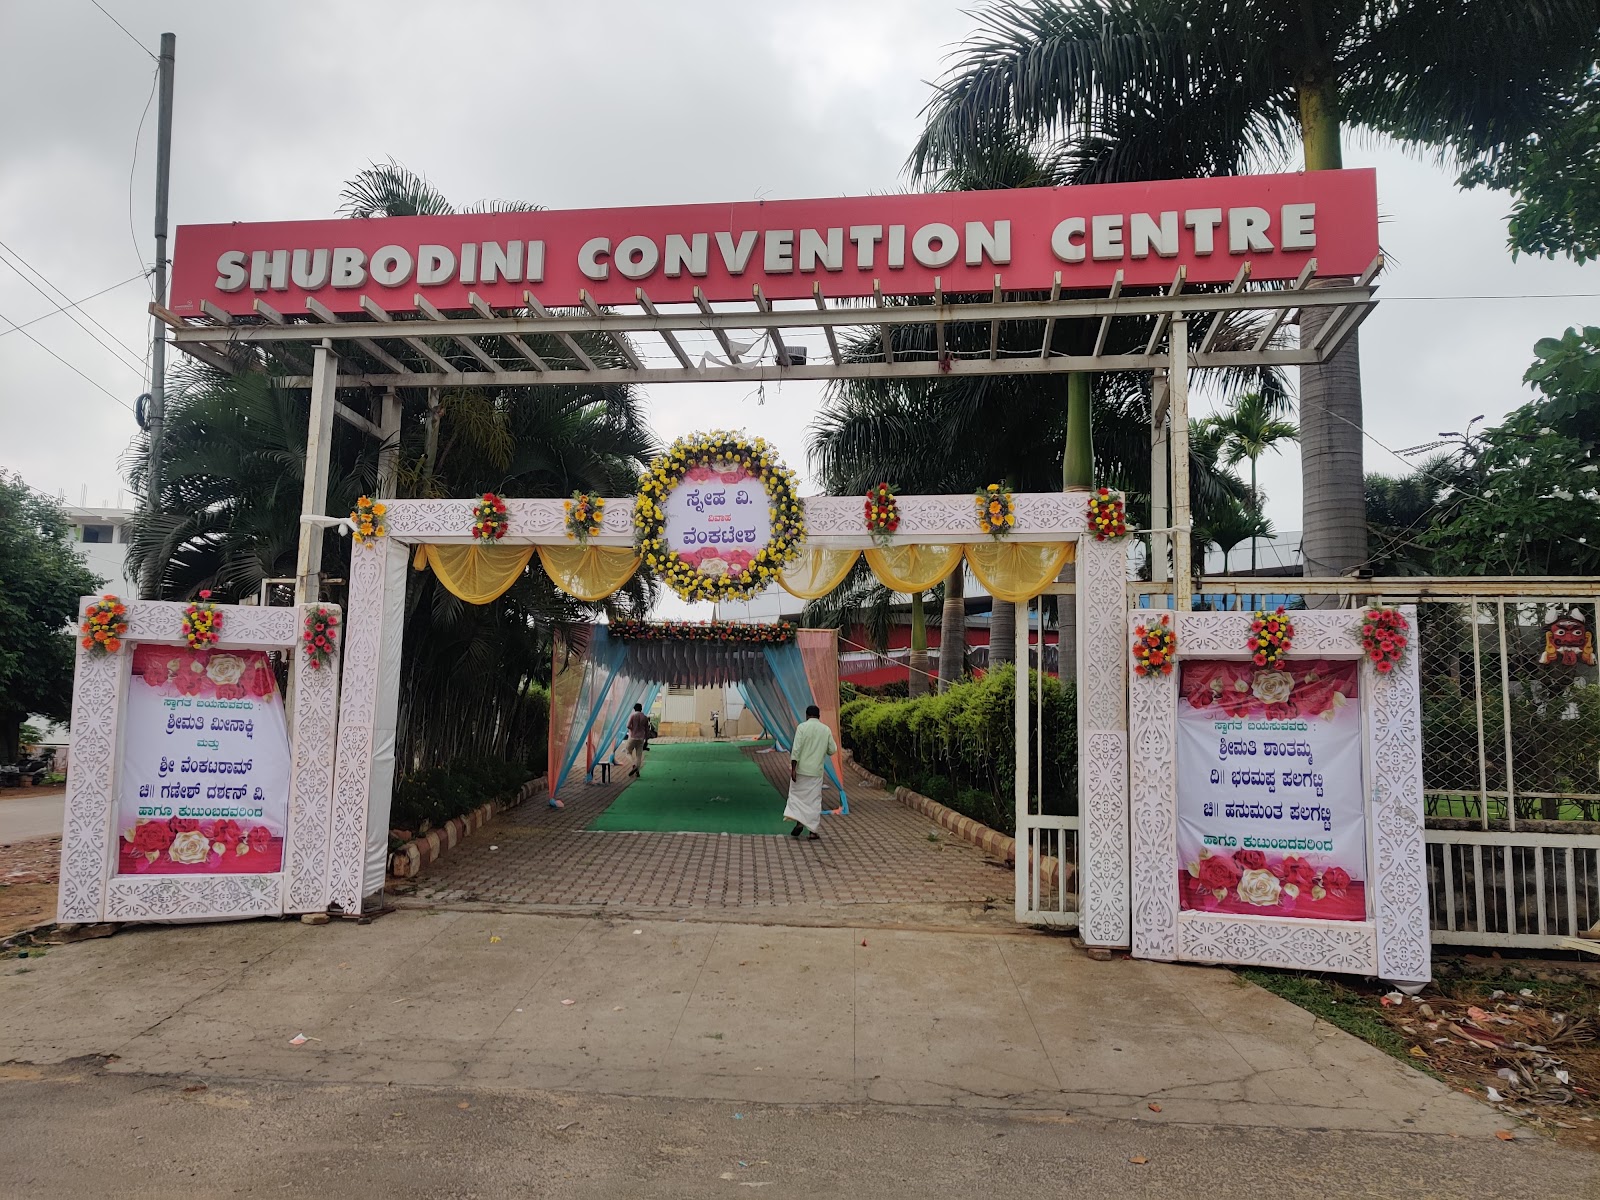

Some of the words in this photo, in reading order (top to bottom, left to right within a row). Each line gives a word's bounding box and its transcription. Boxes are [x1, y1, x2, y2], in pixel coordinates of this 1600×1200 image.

[215, 239, 546, 292] SHUBODINI
[577, 219, 1012, 281] CONVENTION
[1051, 202, 1317, 264] CENTRE
[687, 488, 726, 512] ಸ್ನೇಹ
[708, 514, 731, 522] ವಿವಾಹ
[683, 525, 756, 544] ವೆಂಕಟೇಶ
[163, 698, 192, 711] ಸ್ವಾಗತ
[166, 713, 204, 734] ಶ್ರೀಮತಿ
[211, 715, 254, 740] ಮೀನಾಕ್ಷಿ
[1214, 720, 1243, 734] ಸ್ವಾಗತ
[1248, 722, 1308, 731] ಬಯಸುವವರು
[197, 739, 220, 751] ಮತ್ತು
[1219, 738, 1257, 760] ಶ್ರೀಮತಿ
[1263, 740, 1313, 765] ಶಾಂತಮ್ಮ
[158, 756, 175, 777] ಶ್ರೀ
[180, 756, 253, 775] ವೆಂಕಟರಾಮ್
[161, 782, 200, 799] ಗಣೇಶ್
[207, 784, 247, 800] ದರ್ಶನ್
[1231, 769, 1276, 793] ಭರಮಪ್ಪ
[1282, 768, 1324, 797] ಪಲಗಟ್ಟಿ
[138, 806, 172, 816] ಹಾಗೂ
[179, 806, 263, 818] ಕುಟುಂಬದವರಿಂದ
[1225, 802, 1283, 819] ಹನುಮಂತ
[1290, 804, 1331, 831] ಪಲಗಟ್ಟಿ
[1203, 834, 1237, 847] ಹಾಗೂ
[1244, 836, 1333, 852] ಕುಟುಂಬದವರಿಂದ
